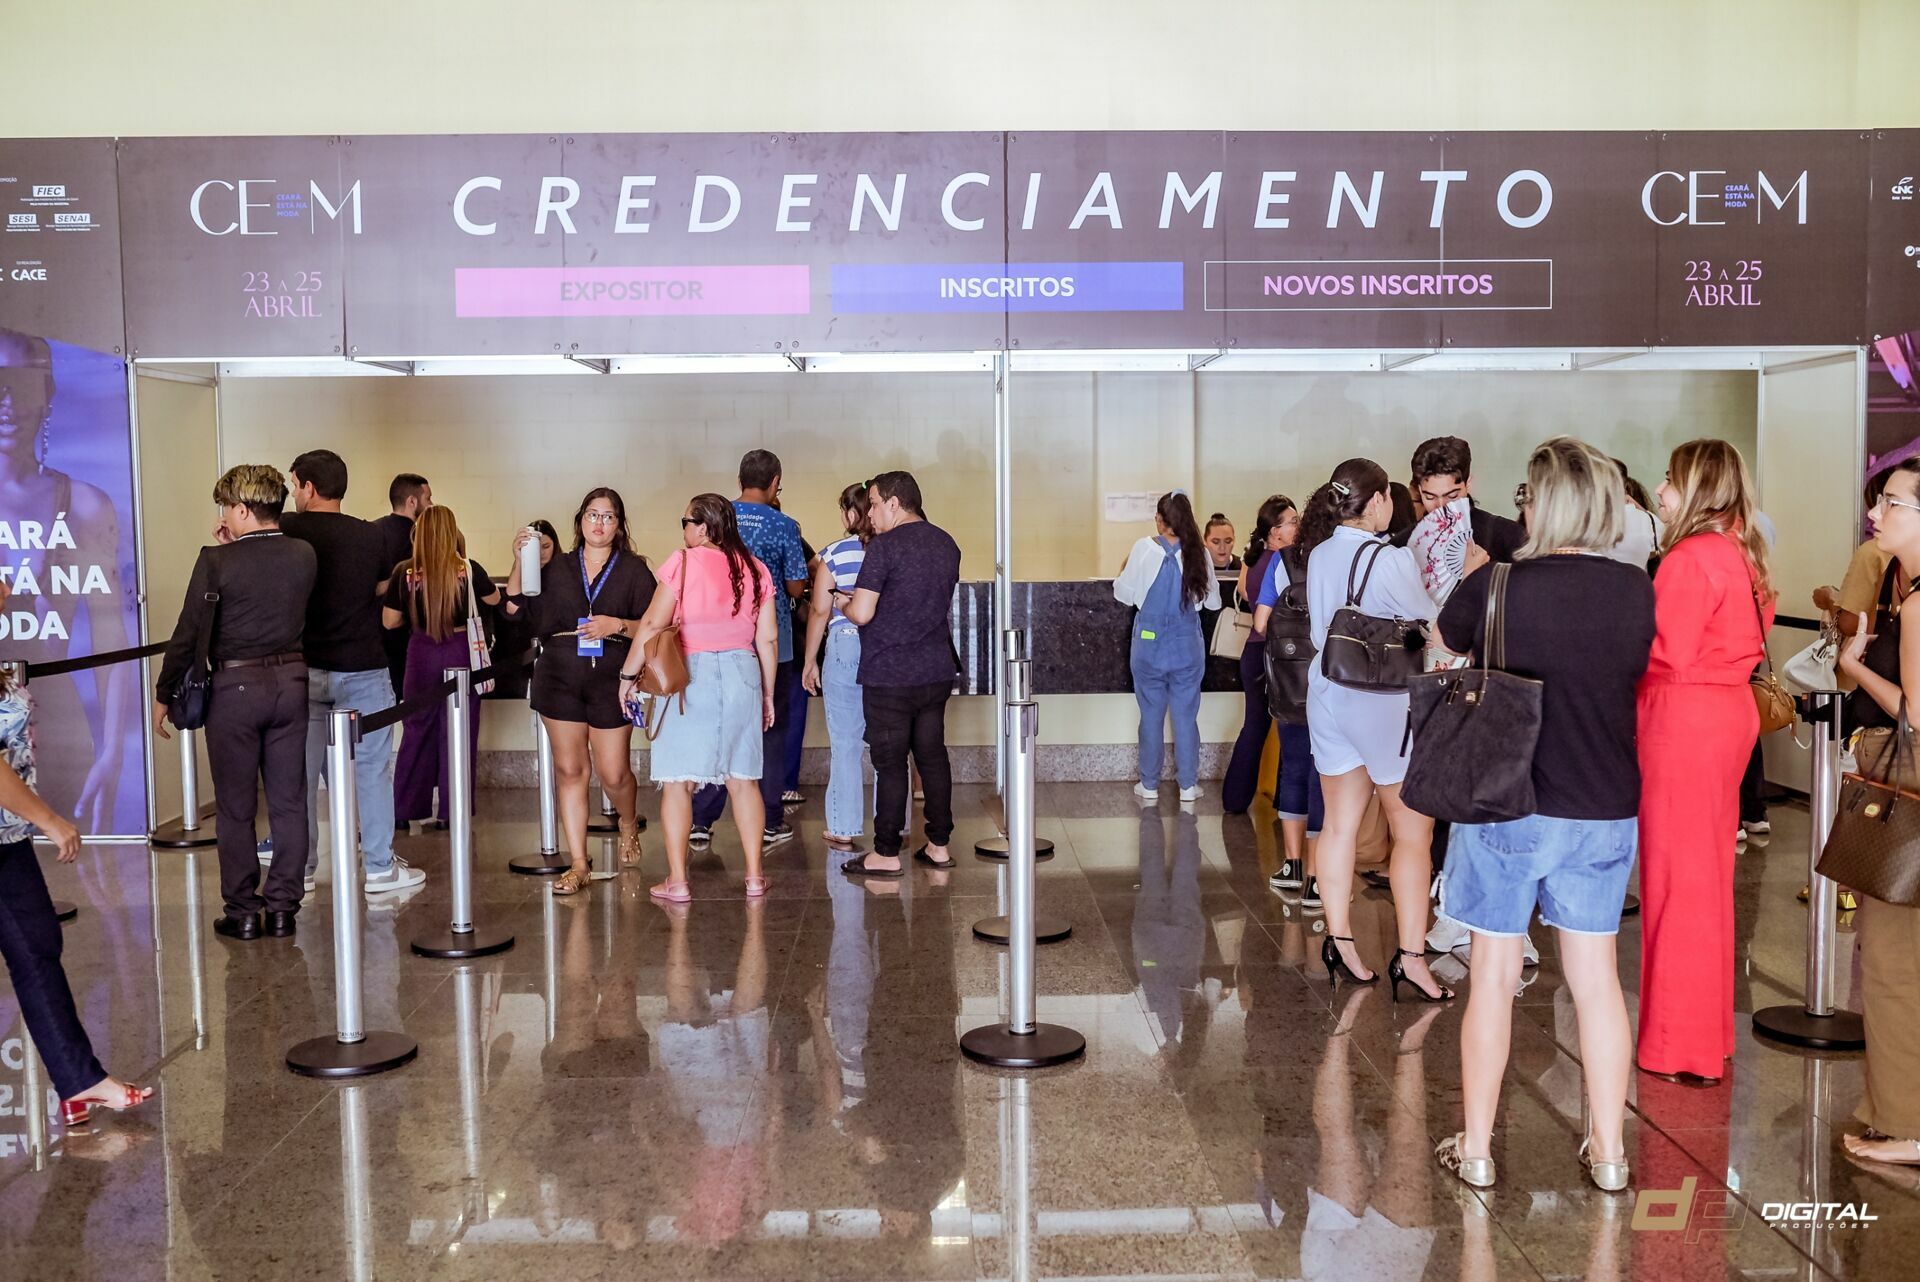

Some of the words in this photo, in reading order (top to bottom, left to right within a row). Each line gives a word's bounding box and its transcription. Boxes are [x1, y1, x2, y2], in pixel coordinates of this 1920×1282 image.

[36, 186, 62, 196] FIEC
[1725, 183, 1750, 191] CEARÁ
[1725, 191, 1743, 200] ESTÁ
[452, 169, 1553, 236] CREDENCIAMENTO
[11, 215, 34, 223] SESI
[56, 214, 87, 223] SENAI
[11, 268, 47, 281] CACE
[1684, 260, 1712, 281] 23
[1719, 268, 1729, 281] A
[1735, 260, 1763, 281] 25
[242, 271, 270, 292] 23
[278, 280, 288, 291] A
[295, 271, 322, 292] 25
[560, 279, 704, 302] EXPOSITOR
[940, 276, 1075, 299] INSCRITOS
[1264, 275, 1355, 296] NOVOS
[1361, 274, 1494, 296] INSCRITOS
[1685, 284, 1761, 306] ABRIL
[244, 295, 322, 317] ABRIL
[50, 565, 112, 594] NA
